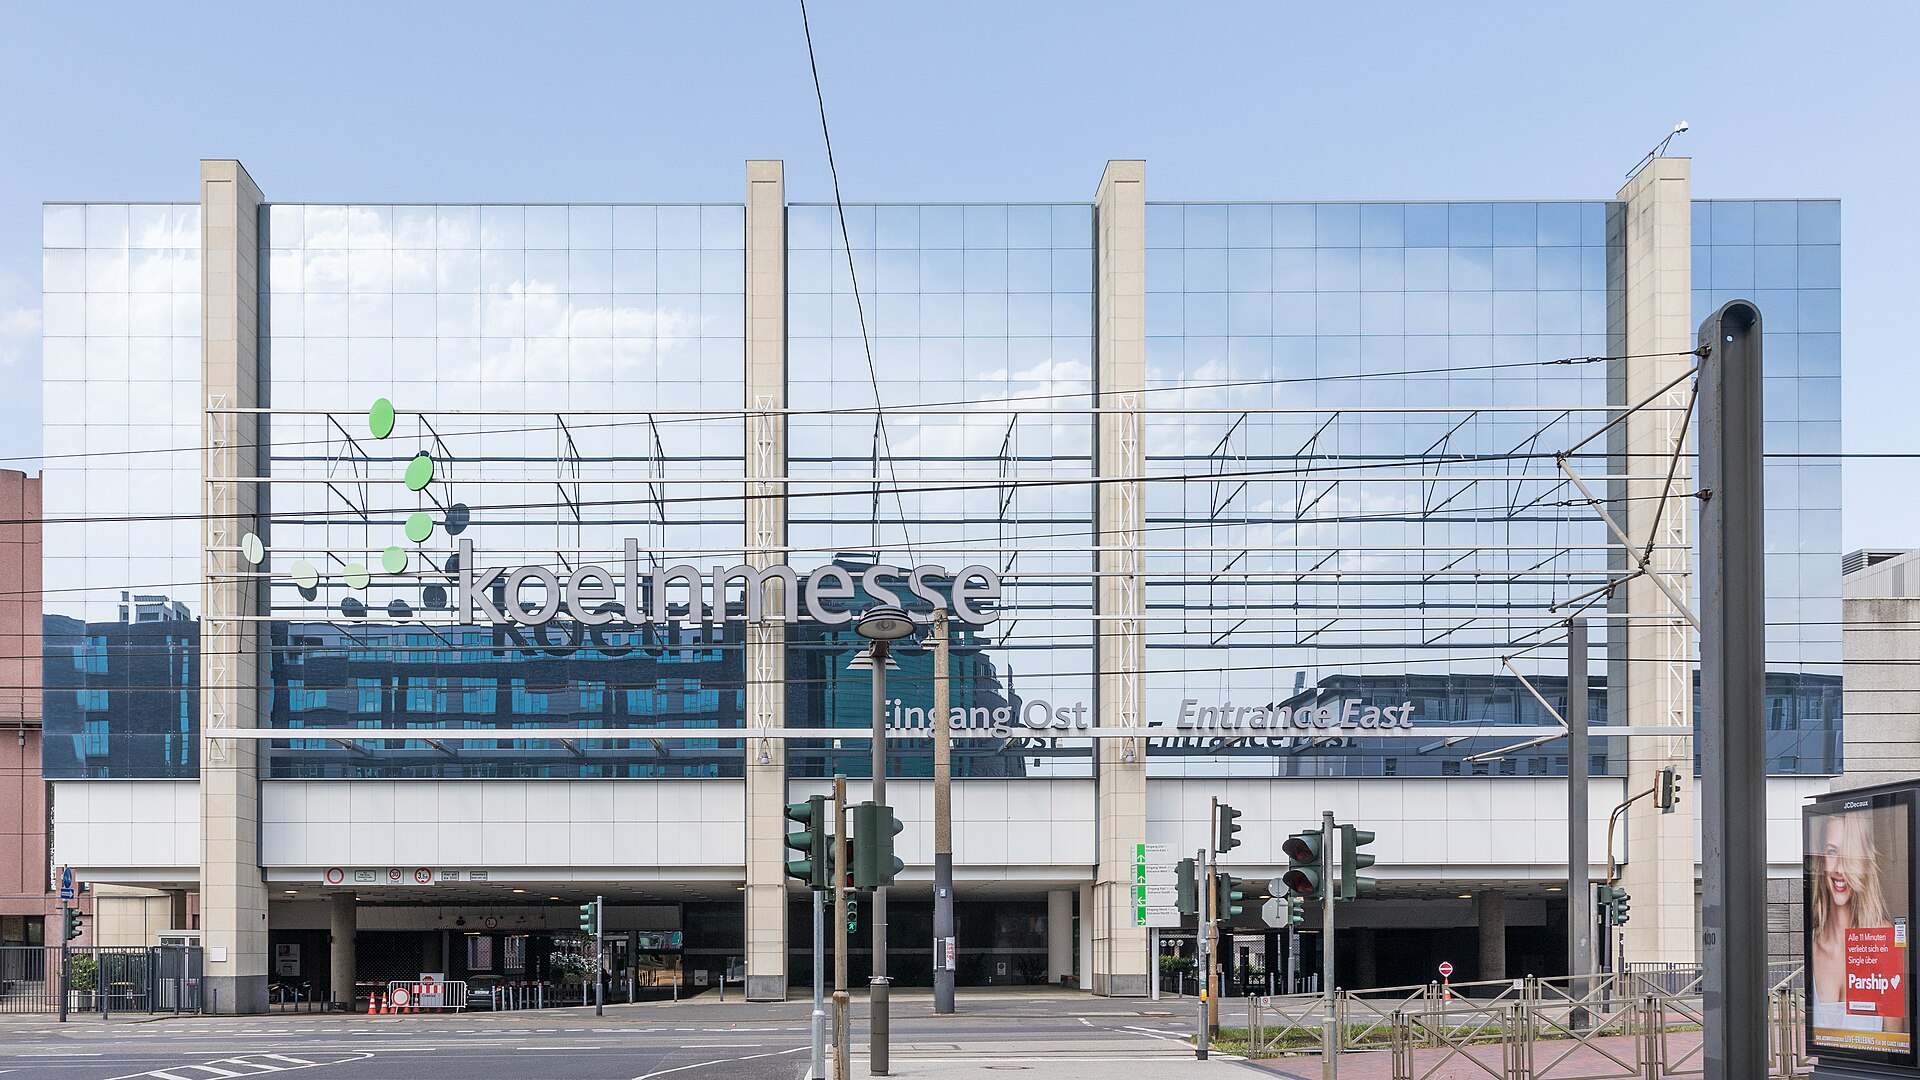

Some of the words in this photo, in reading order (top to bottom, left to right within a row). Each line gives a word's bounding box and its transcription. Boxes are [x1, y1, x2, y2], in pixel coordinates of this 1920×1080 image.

[459, 538, 1000, 626] koelnmesse
[1023, 699, 1089, 729] Ost
[1176, 698, 1333, 730] Entrance
[1340, 698, 1414, 730] East
[1843, 800, 1869, 810] JCDecaux
[1848, 933, 1859, 941] Alle
[1864, 933, 1887, 941] Minuten
[1848, 945, 1867, 953] verliebt
[1868, 945, 1879, 953] sich
[1848, 956, 1864, 966] Single
[1865, 956, 1878, 964] über
[1848, 973, 1889, 995] Parship
